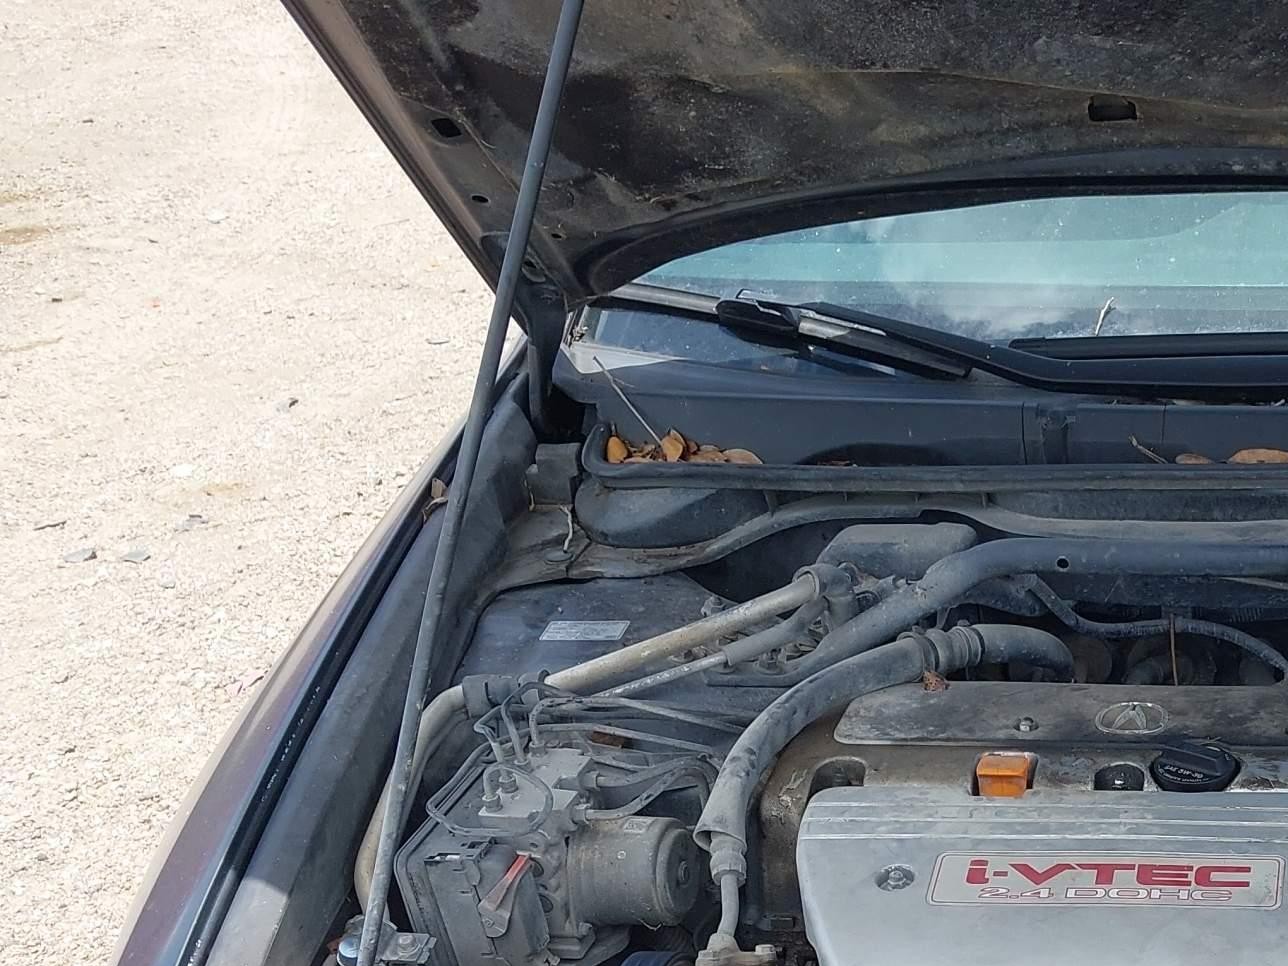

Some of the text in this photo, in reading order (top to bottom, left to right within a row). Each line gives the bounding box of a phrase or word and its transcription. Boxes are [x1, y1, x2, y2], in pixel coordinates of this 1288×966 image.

[965, 859, 1252, 888] i-VTEC
[978, 887, 1232, 901] 2.4 DOHC
